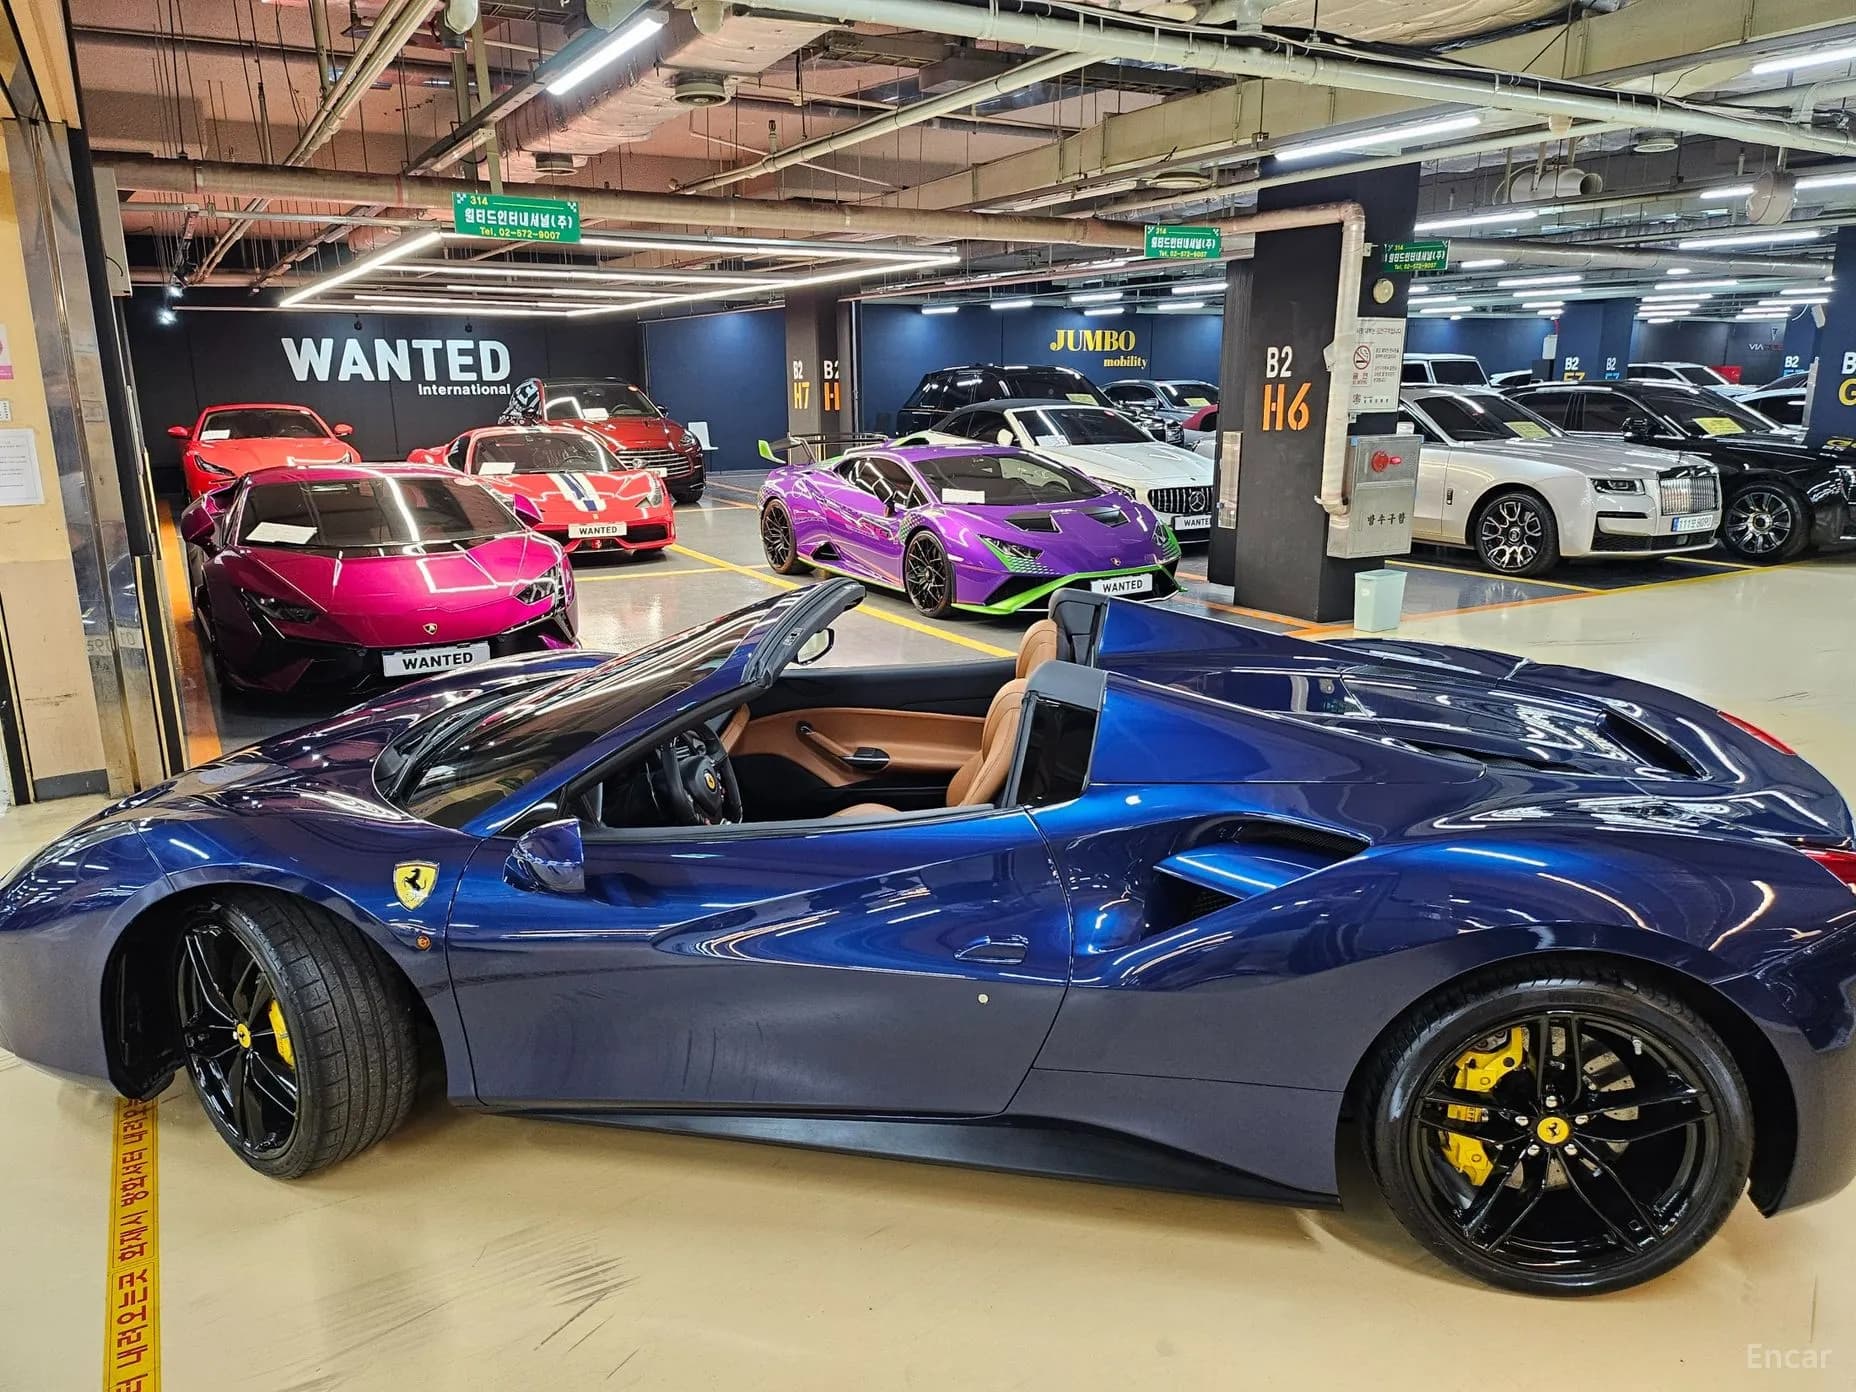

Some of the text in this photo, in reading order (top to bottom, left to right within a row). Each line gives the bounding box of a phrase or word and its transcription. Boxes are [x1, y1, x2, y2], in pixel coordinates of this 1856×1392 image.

[470, 195, 489, 206] 314
[464, 208, 573, 229] 원티드인터내셔널(주)
[480, 226, 561, 240] Tel. 02-572-9007
[1049, 328, 1136, 352] JUMBO
[281, 337, 512, 381] WANTED
[1103, 355, 1149, 370] mobility
[1266, 345, 1294, 379] B2
[1564, 357, 1580, 371] B2
[1606, 357, 1617, 371] B2
[1784, 355, 1800, 368] B2
[793, 360, 803, 379] B2
[418, 383, 511, 395] International
[793, 381, 810, 410] H7
[1262, 382, 1312, 431] H6
[1184, 518, 1209, 526] WANTE
[579, 526, 618, 535] WANTED
[1102, 579, 1143, 593] WANTED
[402, 652, 473, 670] WANTED
